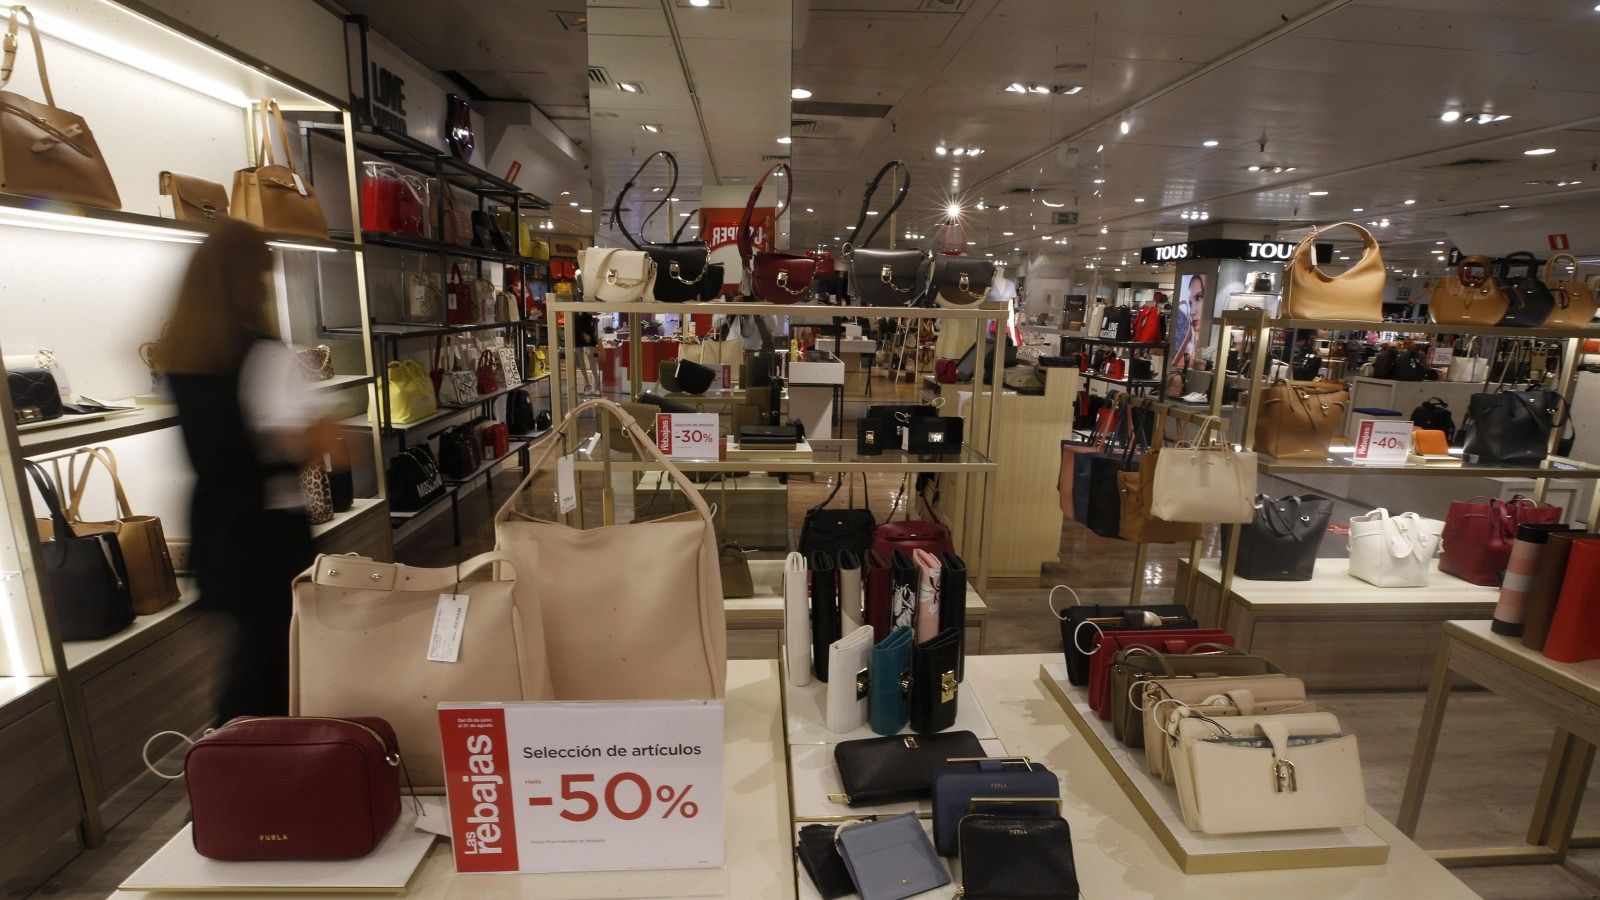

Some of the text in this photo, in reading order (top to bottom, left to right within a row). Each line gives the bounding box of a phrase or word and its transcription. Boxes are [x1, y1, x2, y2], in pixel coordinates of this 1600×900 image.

[1155, 243, 1188, 261] TOUS
[1249, 242, 1297, 259] TOU
[661, 420, 670, 451] rebajas
[675, 429, 713, 443] -30%
[1372, 437, 1405, 449] -40%
[523, 743, 702, 759] Selección de artículos
[462, 734, 503, 855] rebajas
[528, 771, 699, 823] -50%
[464, 831, 479, 855] Las
